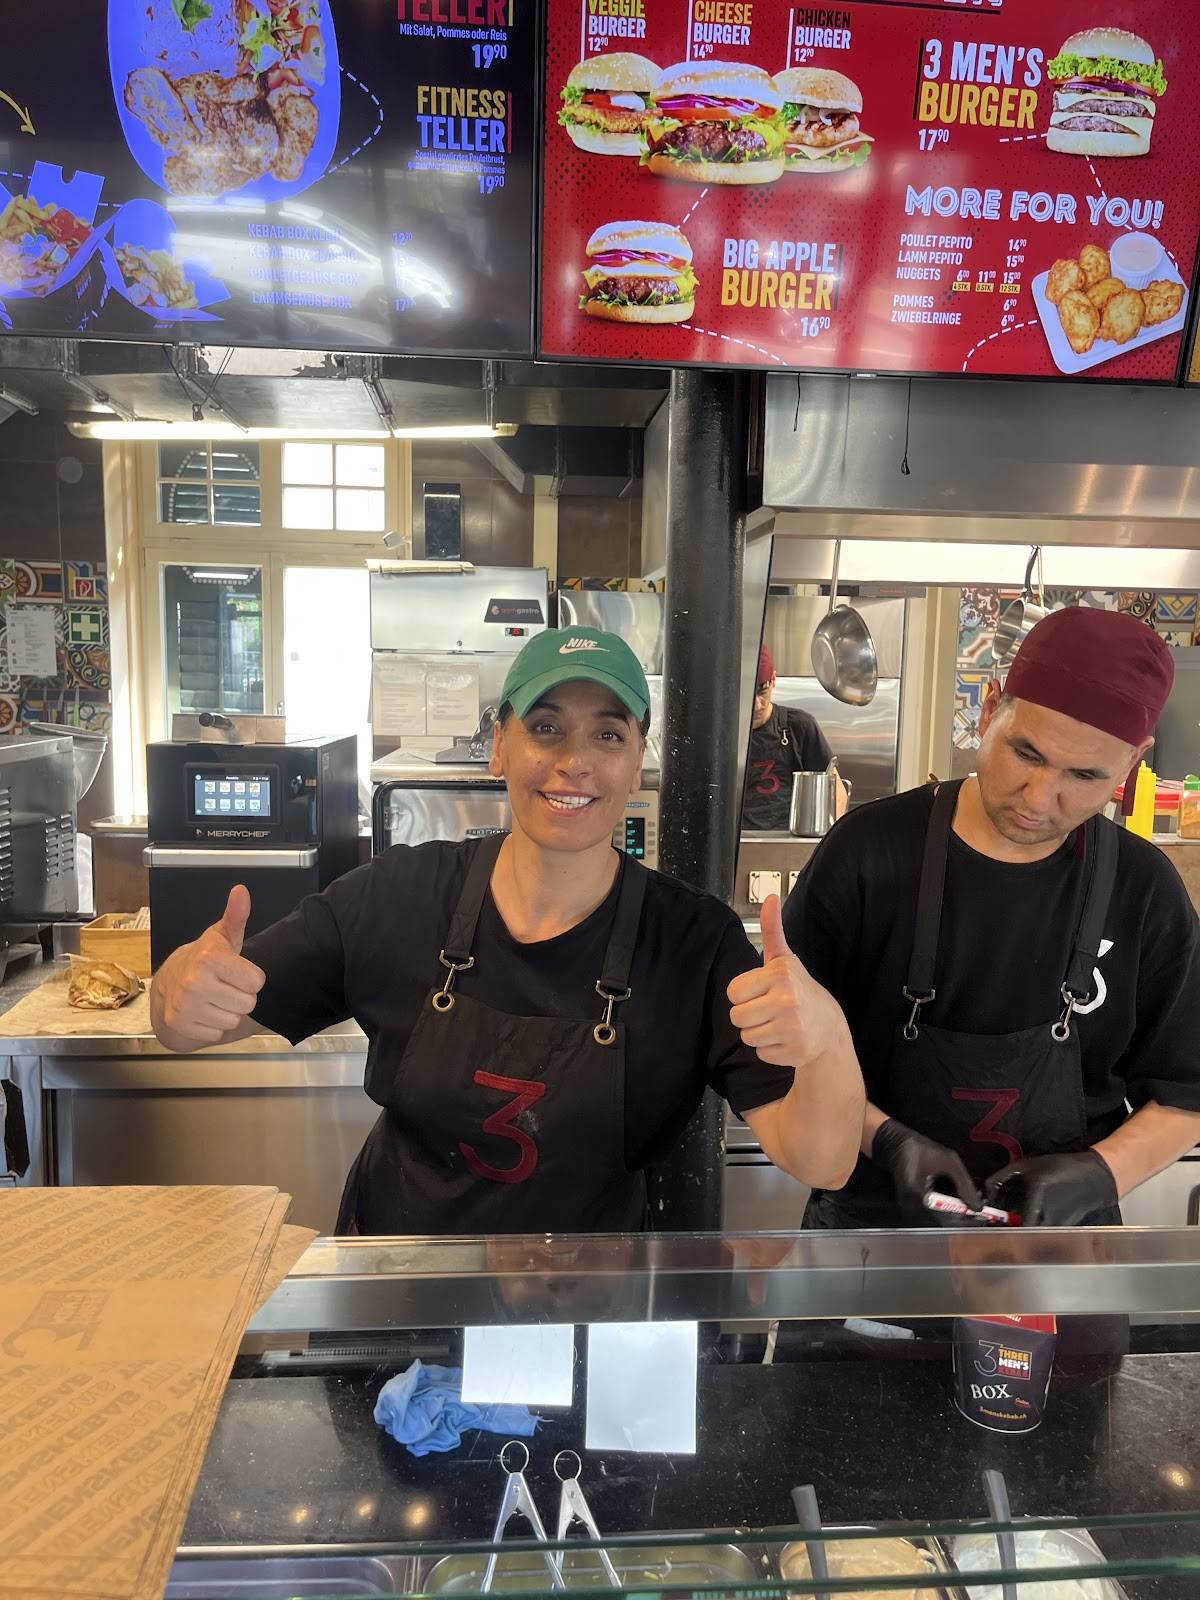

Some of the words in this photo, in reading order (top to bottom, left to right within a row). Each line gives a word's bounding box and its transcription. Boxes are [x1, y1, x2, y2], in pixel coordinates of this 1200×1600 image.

[587, 0, 646, 18] VEGGIE
[694, 0, 753, 25] CHEESE
[796, 7, 852, 28] CHICKEN
[400, 23, 413, 36] Mit
[413, 25, 436, 39] Salat,
[437, 26, 470, 39] Pommes
[471, 28, 489, 40] oder
[490, 29, 507, 41] Reis
[588, 15, 646, 39] BURGER
[693, 22, 751, 46] BURGER
[795, 26, 851, 50] BURGER
[923, 38, 943, 79] 3
[950, 41, 1044, 87] MEN'S
[417, 85, 506, 120] FITNESS
[918, 81, 1038, 129] BURGER
[416, 115, 506, 153] TELLER
[904, 184, 1002, 221] MORE
[1009, 190, 1076, 225] FOR
[1086, 195, 1164, 229] YOU!
[900, 233, 937, 248] POULET
[938, 235, 973, 250] PEPITO
[723, 238, 759, 269] BIG
[765, 240, 836, 272] APPLE
[898, 251, 927, 264] LAMM
[928, 252, 963, 265] PEPITO
[896, 267, 941, 281] NUGGETS
[721, 269, 835, 311] BURGER
[893, 294, 935, 308] POMMES
[890, 310, 962, 325] ZWIEBELRINGE
[566, 637, 598, 649] NIKE
[751, 759, 781, 795] 3
[207, 830, 271, 838] MERRYCHEF
[458, 1070, 546, 1184] 3
[951, 1087, 1024, 1167] 3
[998, 1348, 1029, 1362] THREE
[998, 1357, 1029, 1371] MEN'S
[970, 1384, 1013, 1399] BOX
